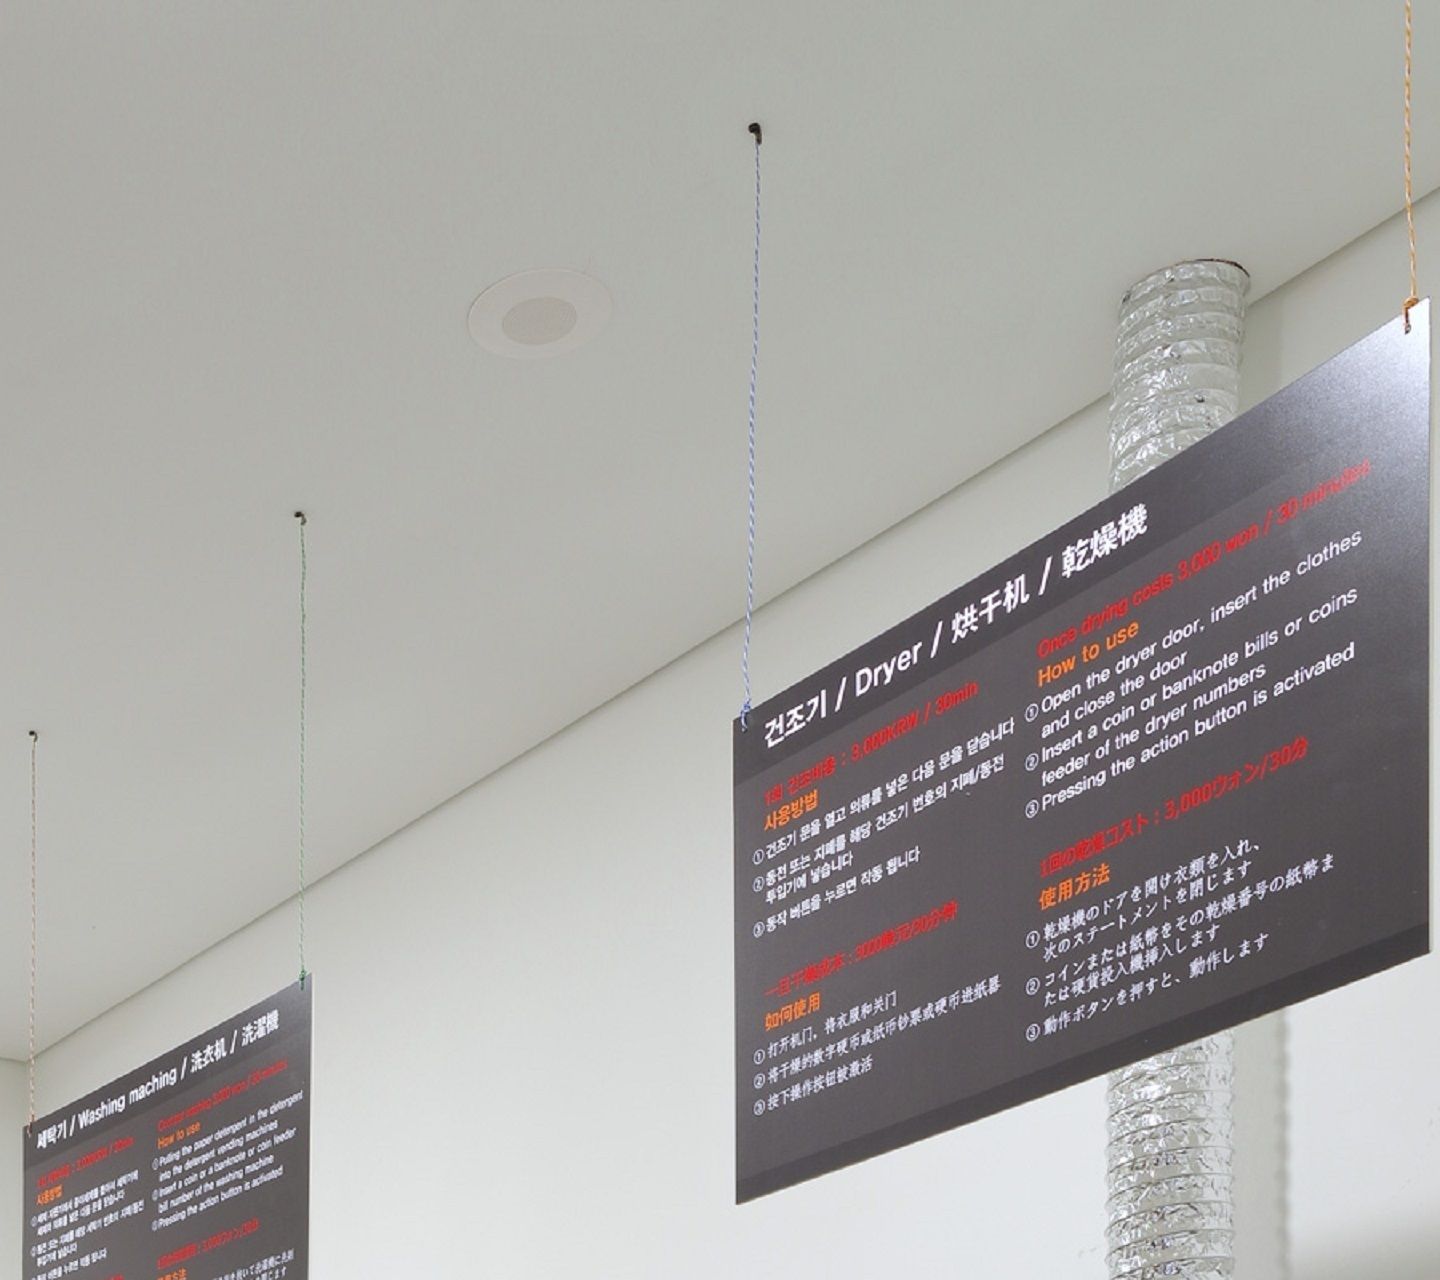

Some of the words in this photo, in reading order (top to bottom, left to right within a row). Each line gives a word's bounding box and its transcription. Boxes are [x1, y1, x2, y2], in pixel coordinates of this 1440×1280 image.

[764, 688, 825, 748] 건조기
[855, 641, 921, 697] Dryer
[952, 573, 1029, 643] 烘干机
[1062, 502, 1147, 578] 乾燥機
[1042, 682, 1081, 713] Open
[1086, 667, 1110, 690] the
[1116, 641, 1157, 675] dryer
[1162, 617, 1204, 649] door,
[1211, 584, 1256, 623] insert
[1263, 569, 1290, 594] the
[1297, 530, 1361, 575] clothes
[1081, 593, 1128, 638] drying
[1037, 654, 1075, 687] How
[1082, 639, 1099, 664] to
[1106, 621, 1138, 652] use
[1042, 729, 1082, 763] Insert
[1088, 724, 1096, 739] a
[1102, 704, 1134, 731] coin
[1140, 692, 1155, 711] or
[1162, 651, 1238, 701] banknote
[1245, 629, 1277, 658] bills
[1284, 616, 1301, 636] or
[1308, 587, 1356, 623] coins
[1041, 709, 1069, 739] and
[1075, 689, 1114, 720] close
[1120, 674, 1144, 697] the
[1150, 650, 1186, 681] door
[1042, 752, 1089, 787] feeder
[1095, 740, 1109, 759] of
[1115, 728, 1139, 750] the
[1144, 702, 1187, 735] dryer
[1193, 663, 1265, 710] numbers
[1042, 769, 1106, 811] Pressing
[1111, 755, 1135, 777] the
[1140, 728, 1188, 763] action
[1195, 699, 1246, 736] button
[1253, 689, 1267, 707] is
[1273, 640, 1354, 697] activated
[764, 788, 817, 835] 사용방법
[876, 801, 908, 831] 건조기
[765, 830, 796, 859] 건조기
[1039, 862, 1109, 911] 使用方法
[764, 992, 820, 1033] 如何使用
[37, 1118, 66, 1148] 세탁기
[79, 1094, 124, 1129] Washing
[157, 1134, 174, 1150] How
[176, 1129, 183, 1141] to
[186, 1121, 200, 1136] use
[257, 1108, 267, 1120] the
[172, 1164, 182, 1175] the
[203, 1180, 213, 1192] the
[187, 1204, 197, 1216] the
